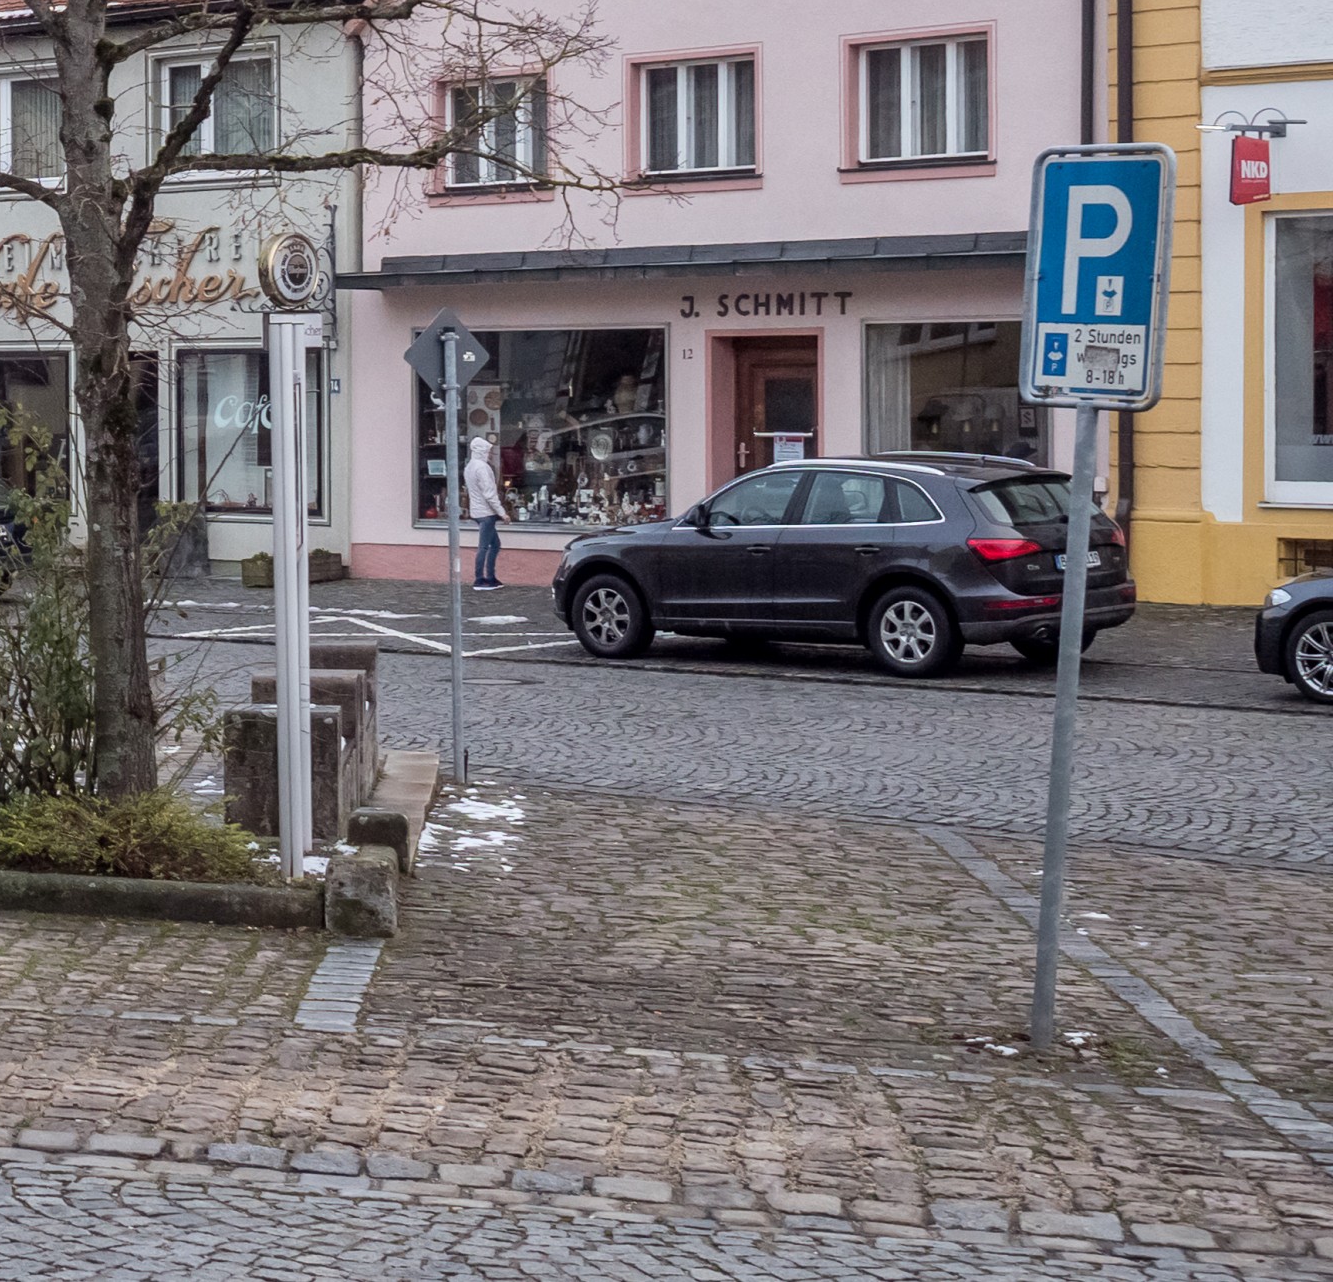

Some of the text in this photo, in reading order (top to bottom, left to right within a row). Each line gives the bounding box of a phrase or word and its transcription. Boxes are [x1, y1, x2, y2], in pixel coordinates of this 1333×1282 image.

[1240, 159, 1269, 179] NKD
[1061, 184, 1133, 315] P
[680, 291, 853, 318] J. SCHMITT
[1074, 328, 1141, 344] 2 Stunden
[682, 348, 694, 360] 12
[1086, 369, 1125, 385] 8-18 h
